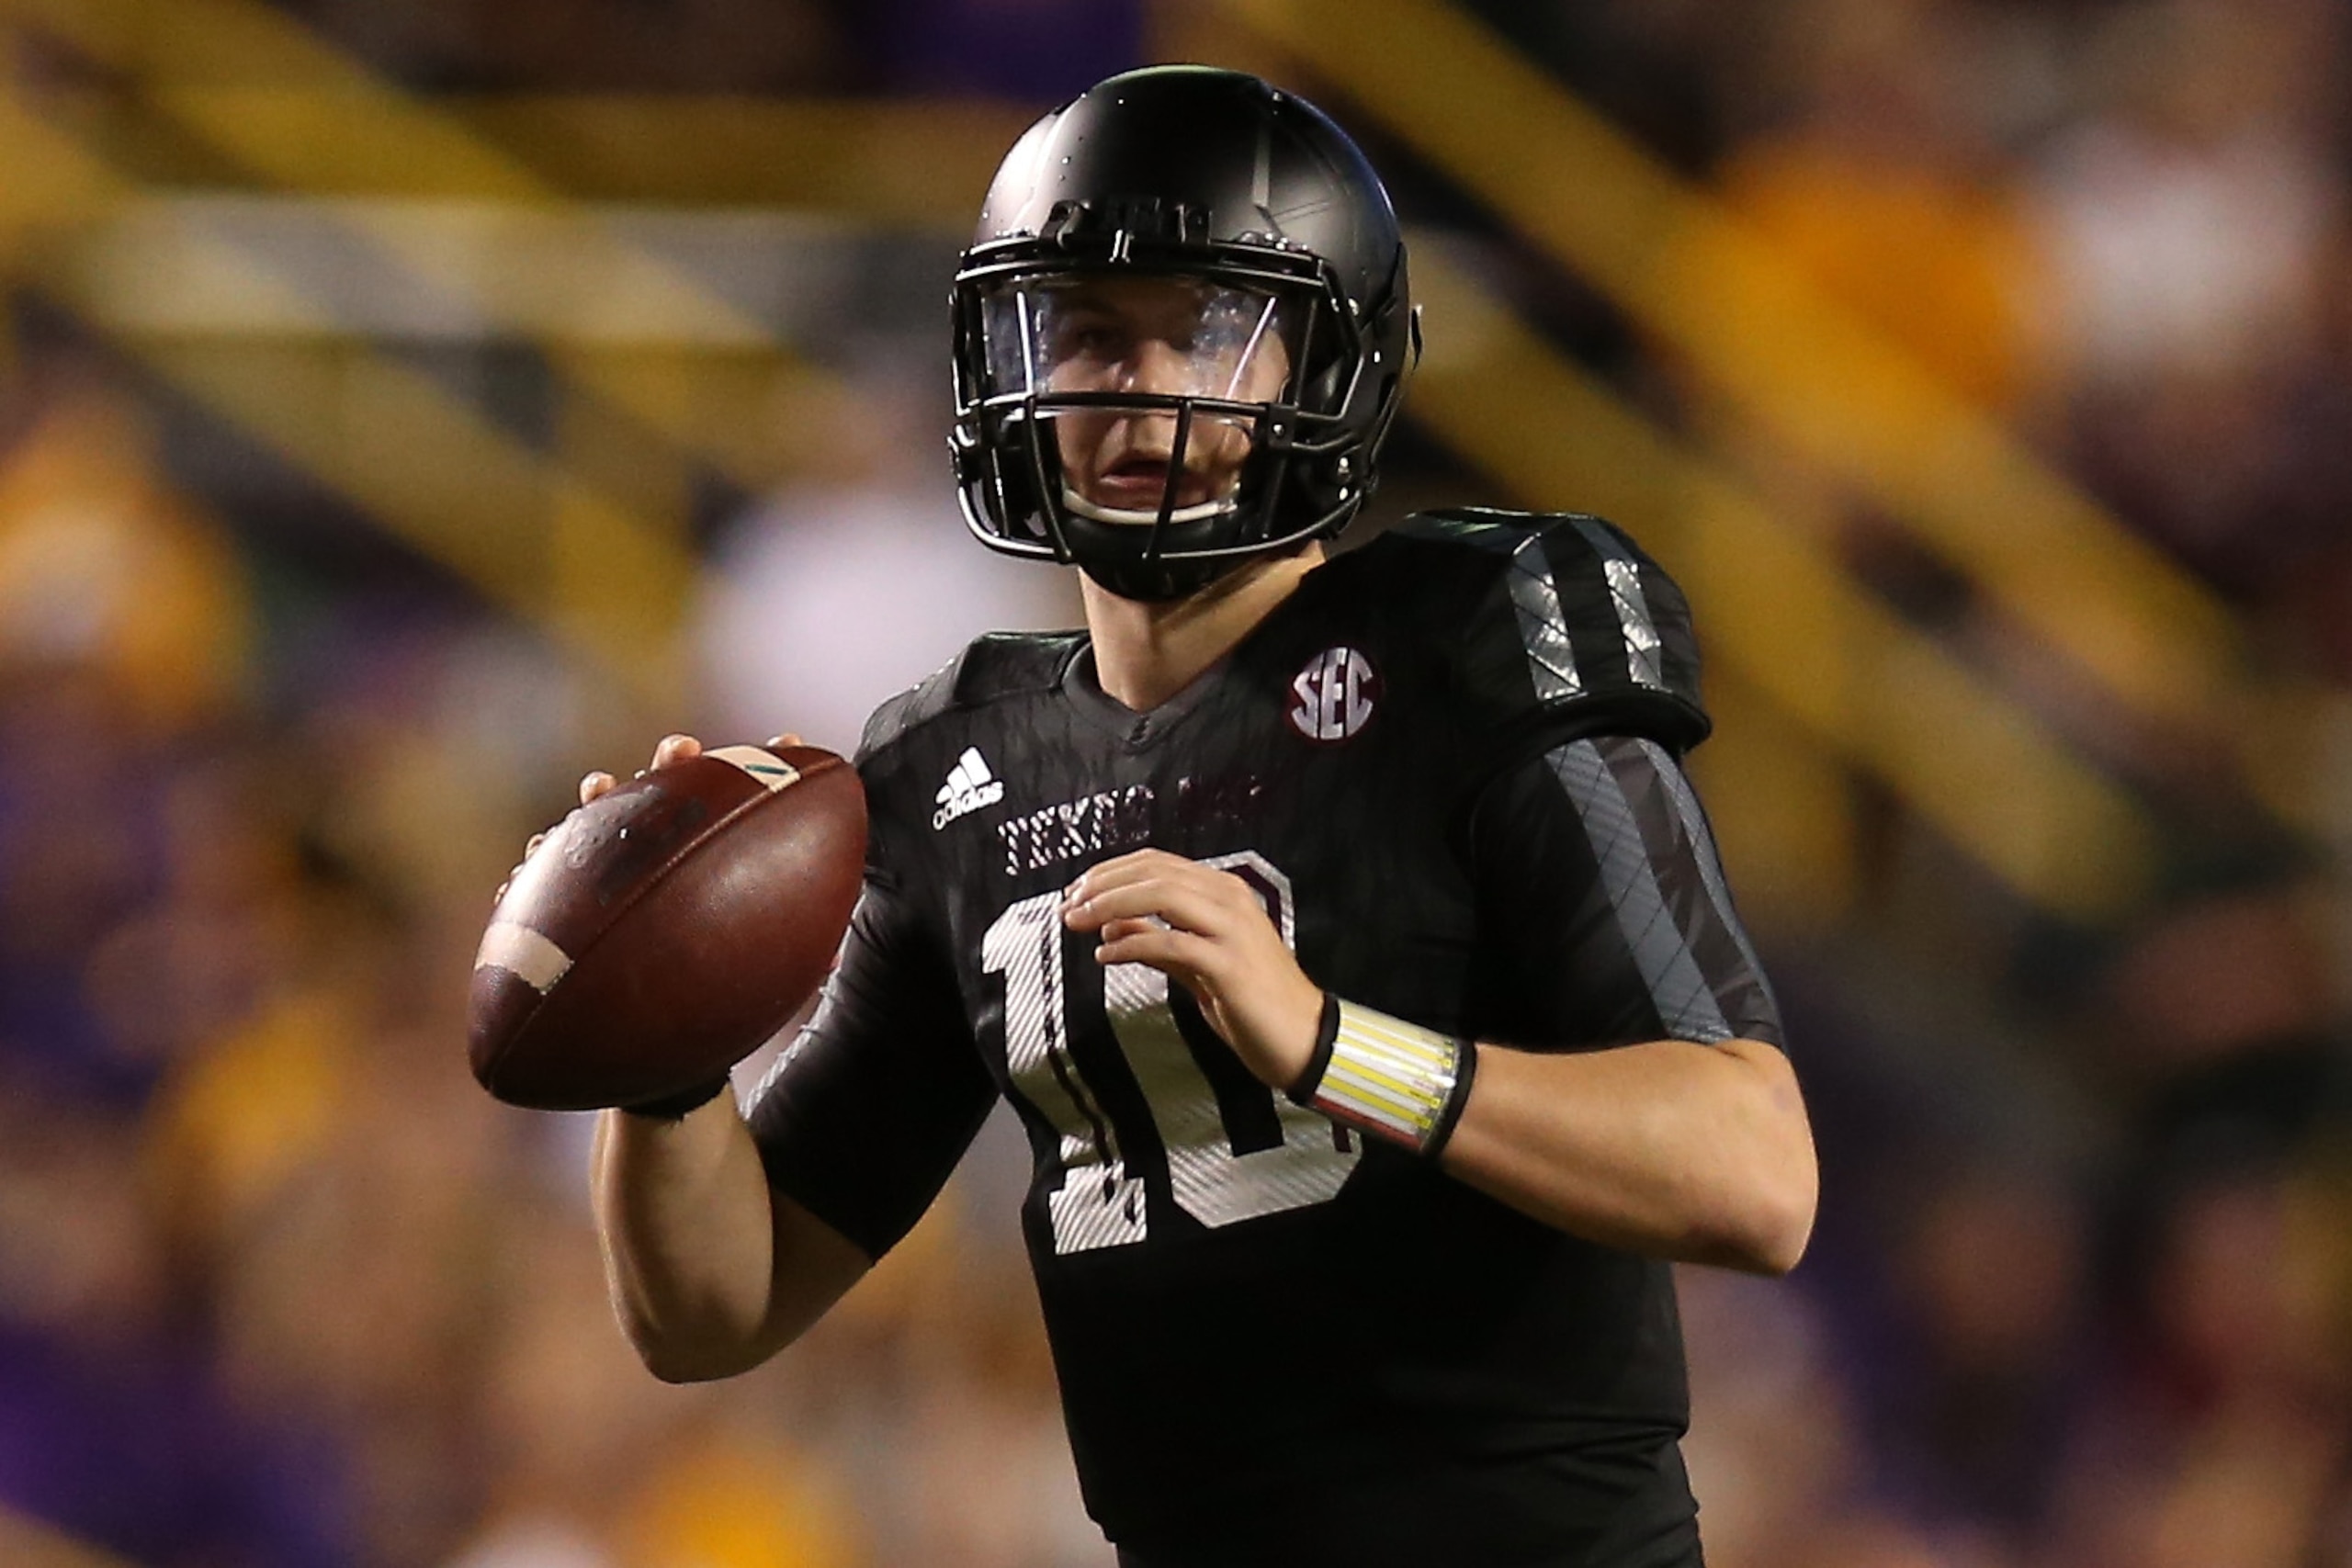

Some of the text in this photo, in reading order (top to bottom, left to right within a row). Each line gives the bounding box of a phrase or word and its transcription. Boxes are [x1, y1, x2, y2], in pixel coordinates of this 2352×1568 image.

[1291, 647, 1374, 739] SEC
[932, 765, 1004, 830] adidas
[981, 850, 1363, 1255] 10
